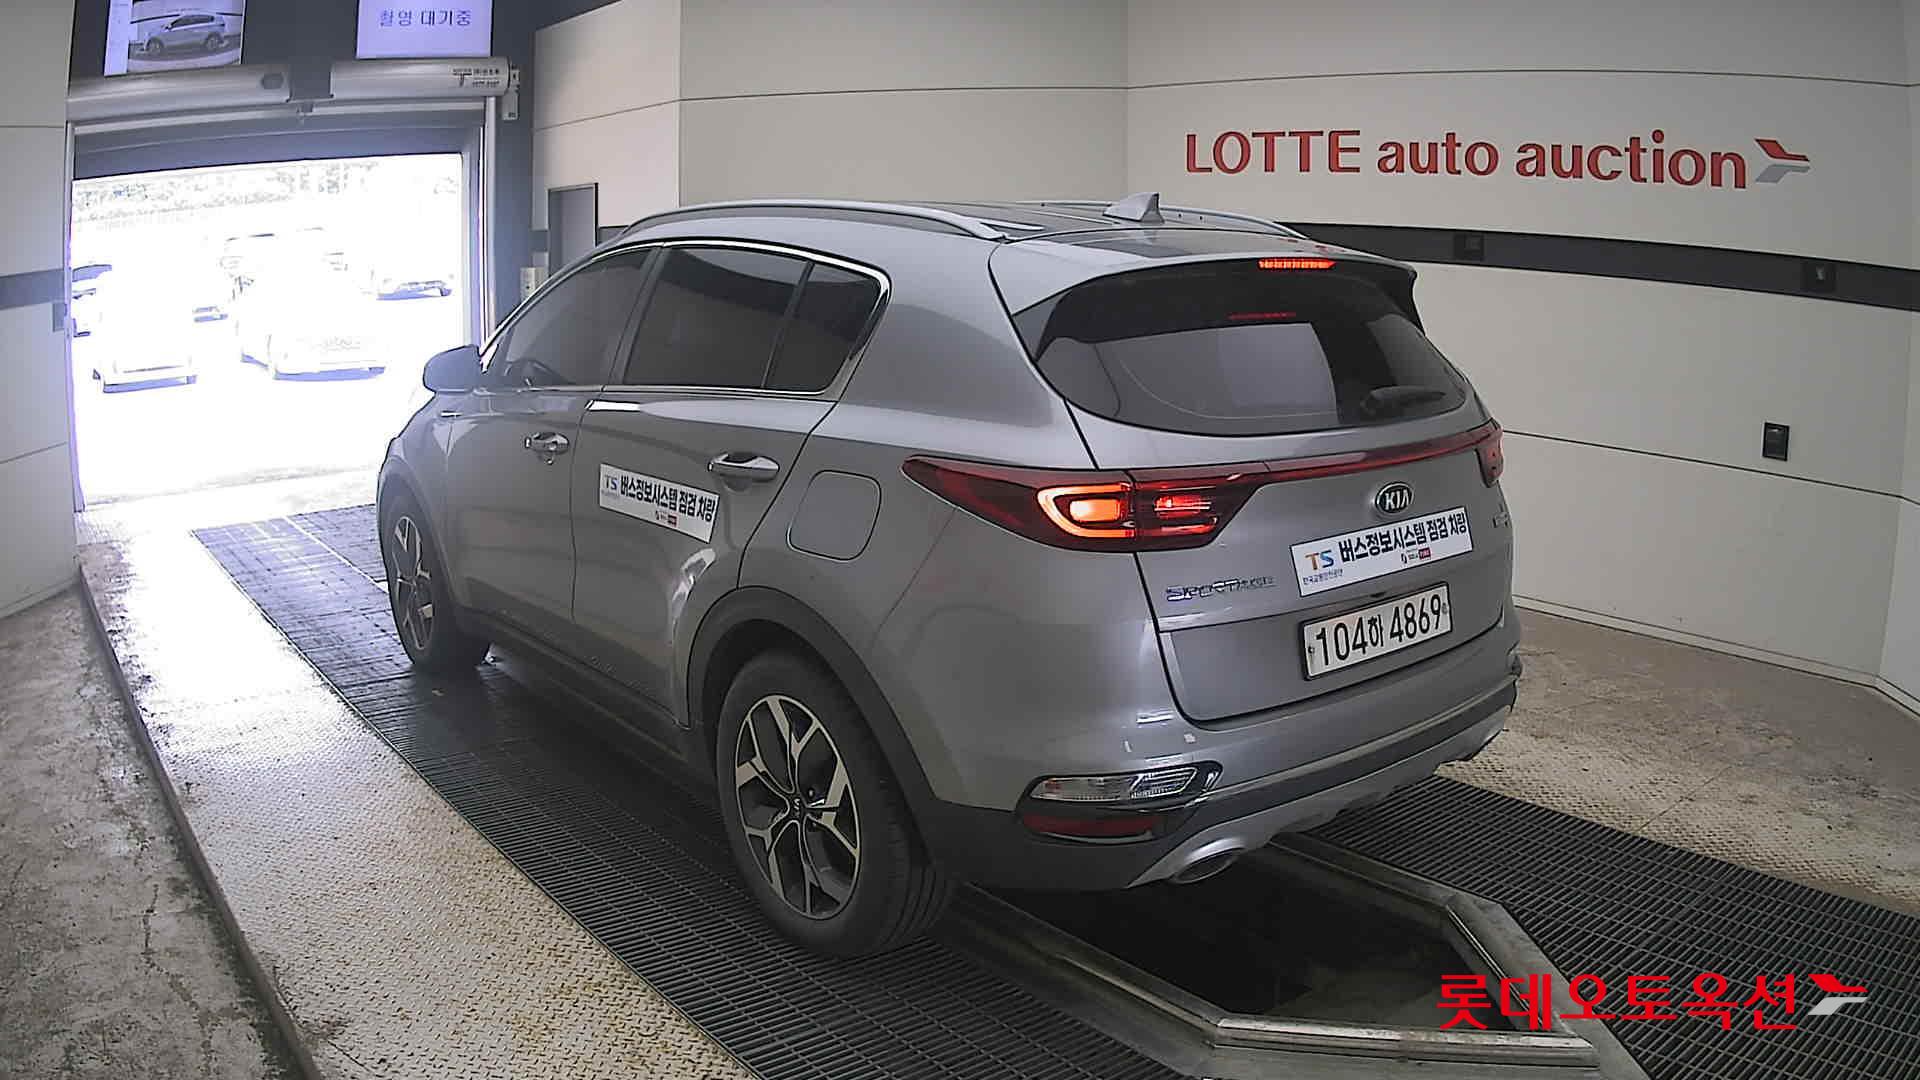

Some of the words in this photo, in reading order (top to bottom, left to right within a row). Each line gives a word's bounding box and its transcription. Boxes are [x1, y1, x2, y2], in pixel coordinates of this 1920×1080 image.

[420, 10, 471, 26] 대기중
[1186, 130, 1360, 173] LOTTE
[1377, 132, 1498, 175] auto
[1515, 130, 1746, 189] auction
[620, 475, 678, 511] 버스정보시스템
[679, 491, 697, 517] 점검
[697, 496, 716, 522] 차량
[1384, 490, 1410, 512] KIA
[1305, 550, 1334, 571] TS
[1339, 520, 1425, 563] 버스정보시스템
[1427, 515, 1449, 541] 점검
[1449, 511, 1467, 536] 차량
[1316, 614, 1384, 665] 104하
[1390, 594, 1442, 642] 4869
